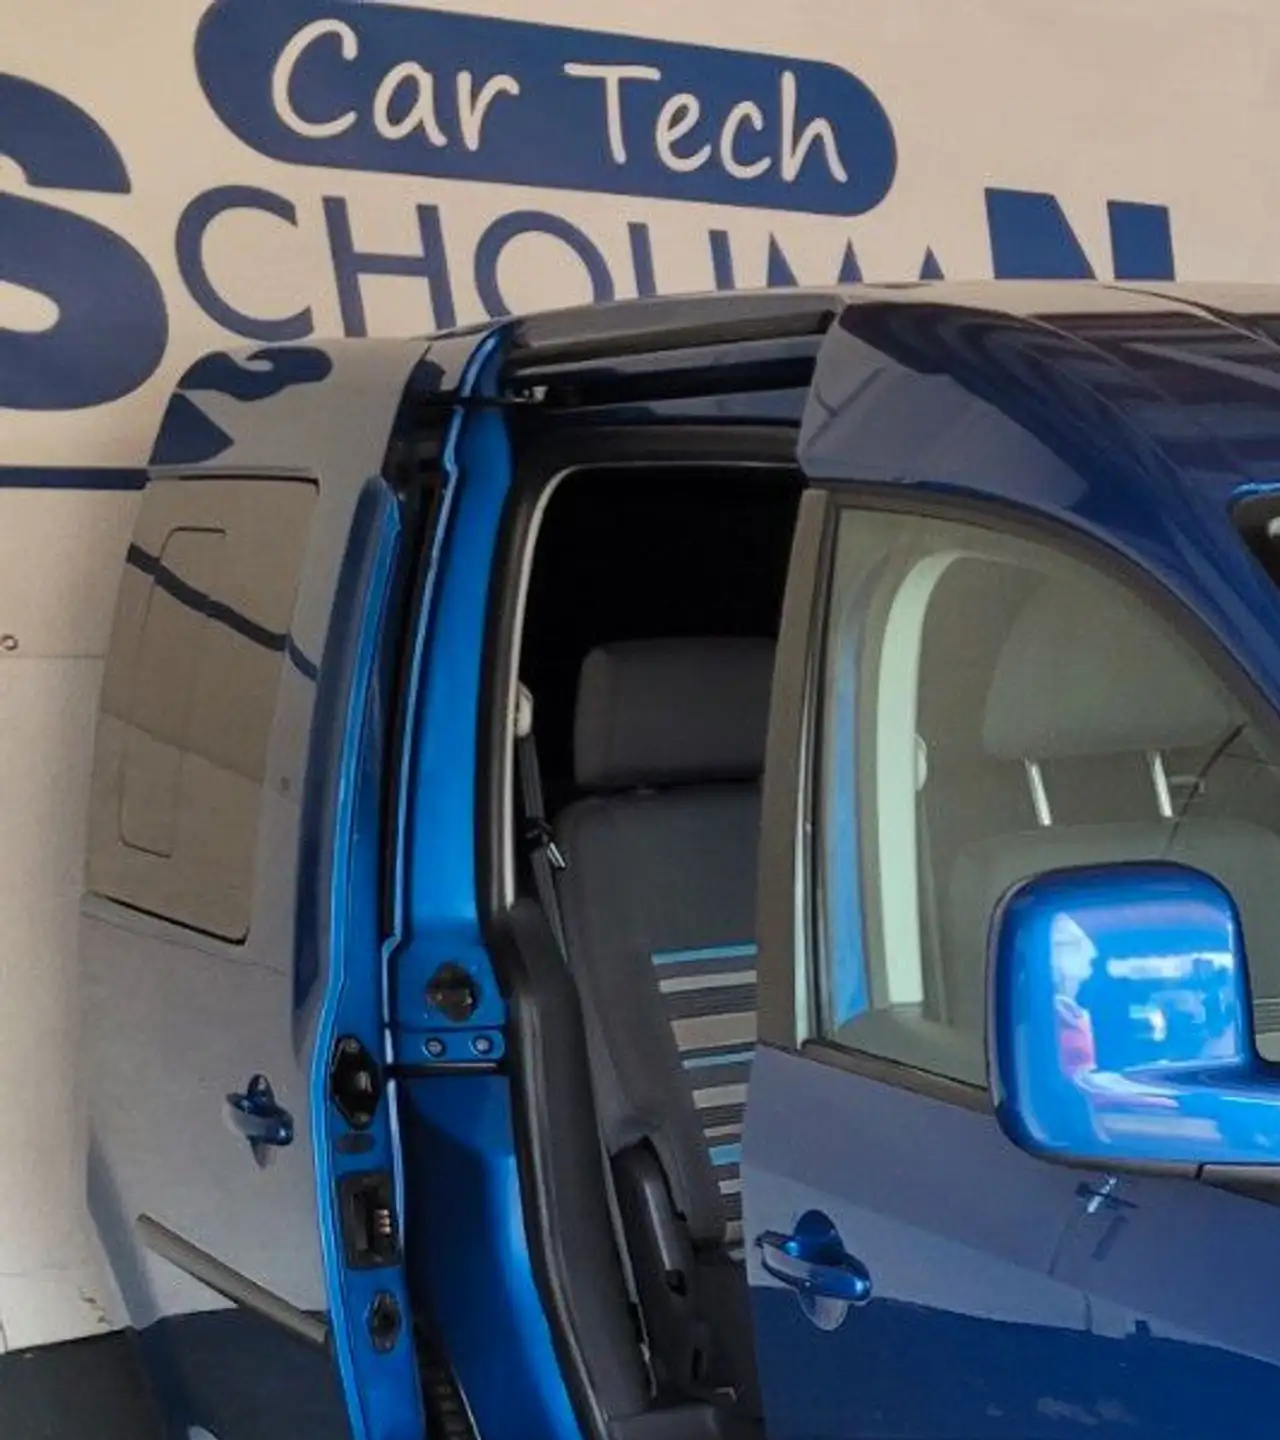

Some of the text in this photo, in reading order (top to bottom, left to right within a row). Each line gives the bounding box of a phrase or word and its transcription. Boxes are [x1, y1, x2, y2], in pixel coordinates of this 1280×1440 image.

[271, 18, 849, 186] Car Tech
[0, 70, 1177, 412] SCHO
